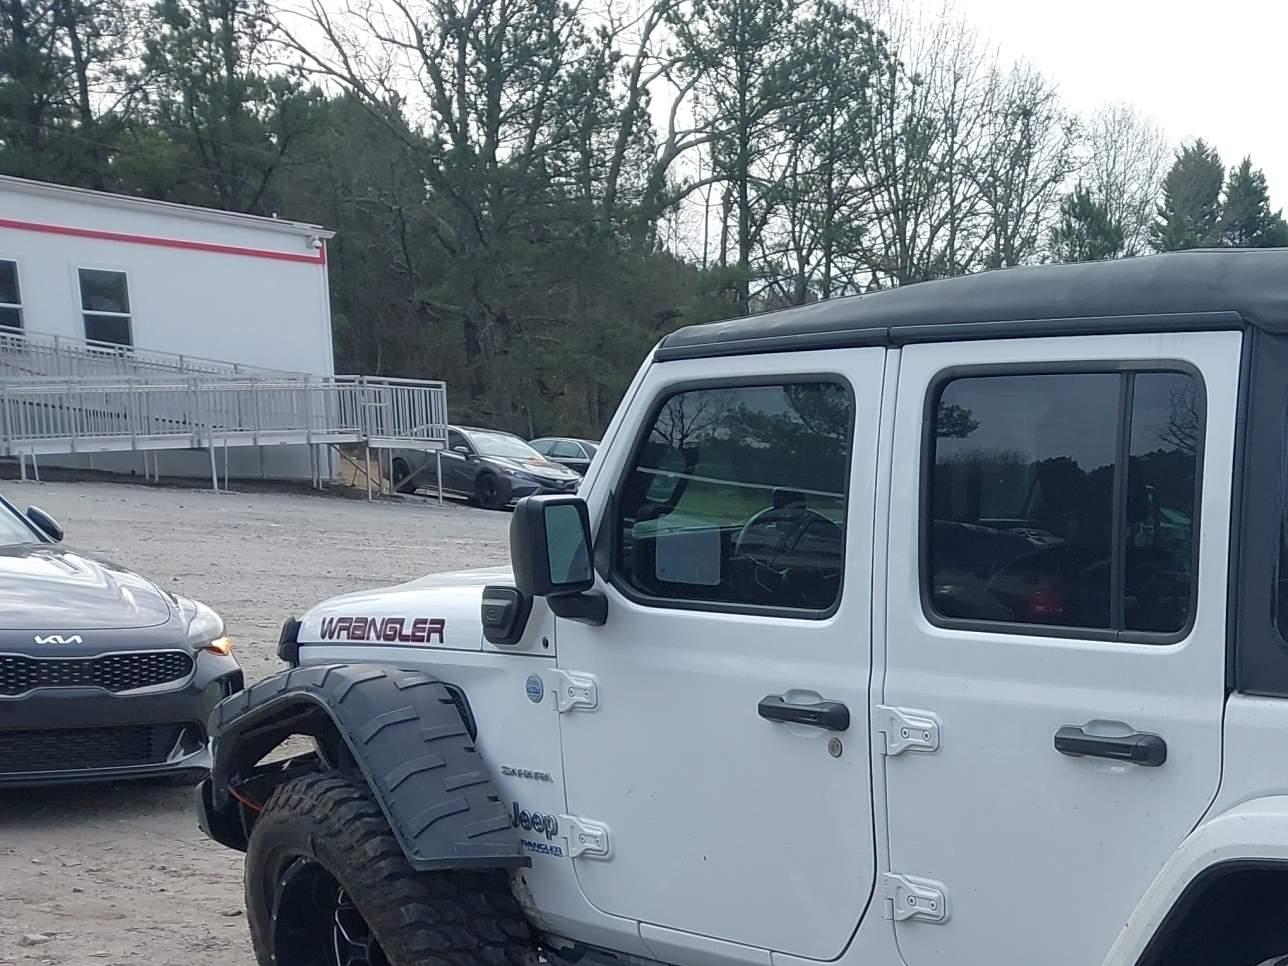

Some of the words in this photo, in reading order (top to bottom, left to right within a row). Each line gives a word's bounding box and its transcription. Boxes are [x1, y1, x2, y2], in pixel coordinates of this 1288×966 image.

[320, 617, 446, 644] WRANGLER
[501, 766, 554, 783] SAHARA
[512, 801, 559, 841] Jeep
[520, 838, 562, 853] RANGLER
